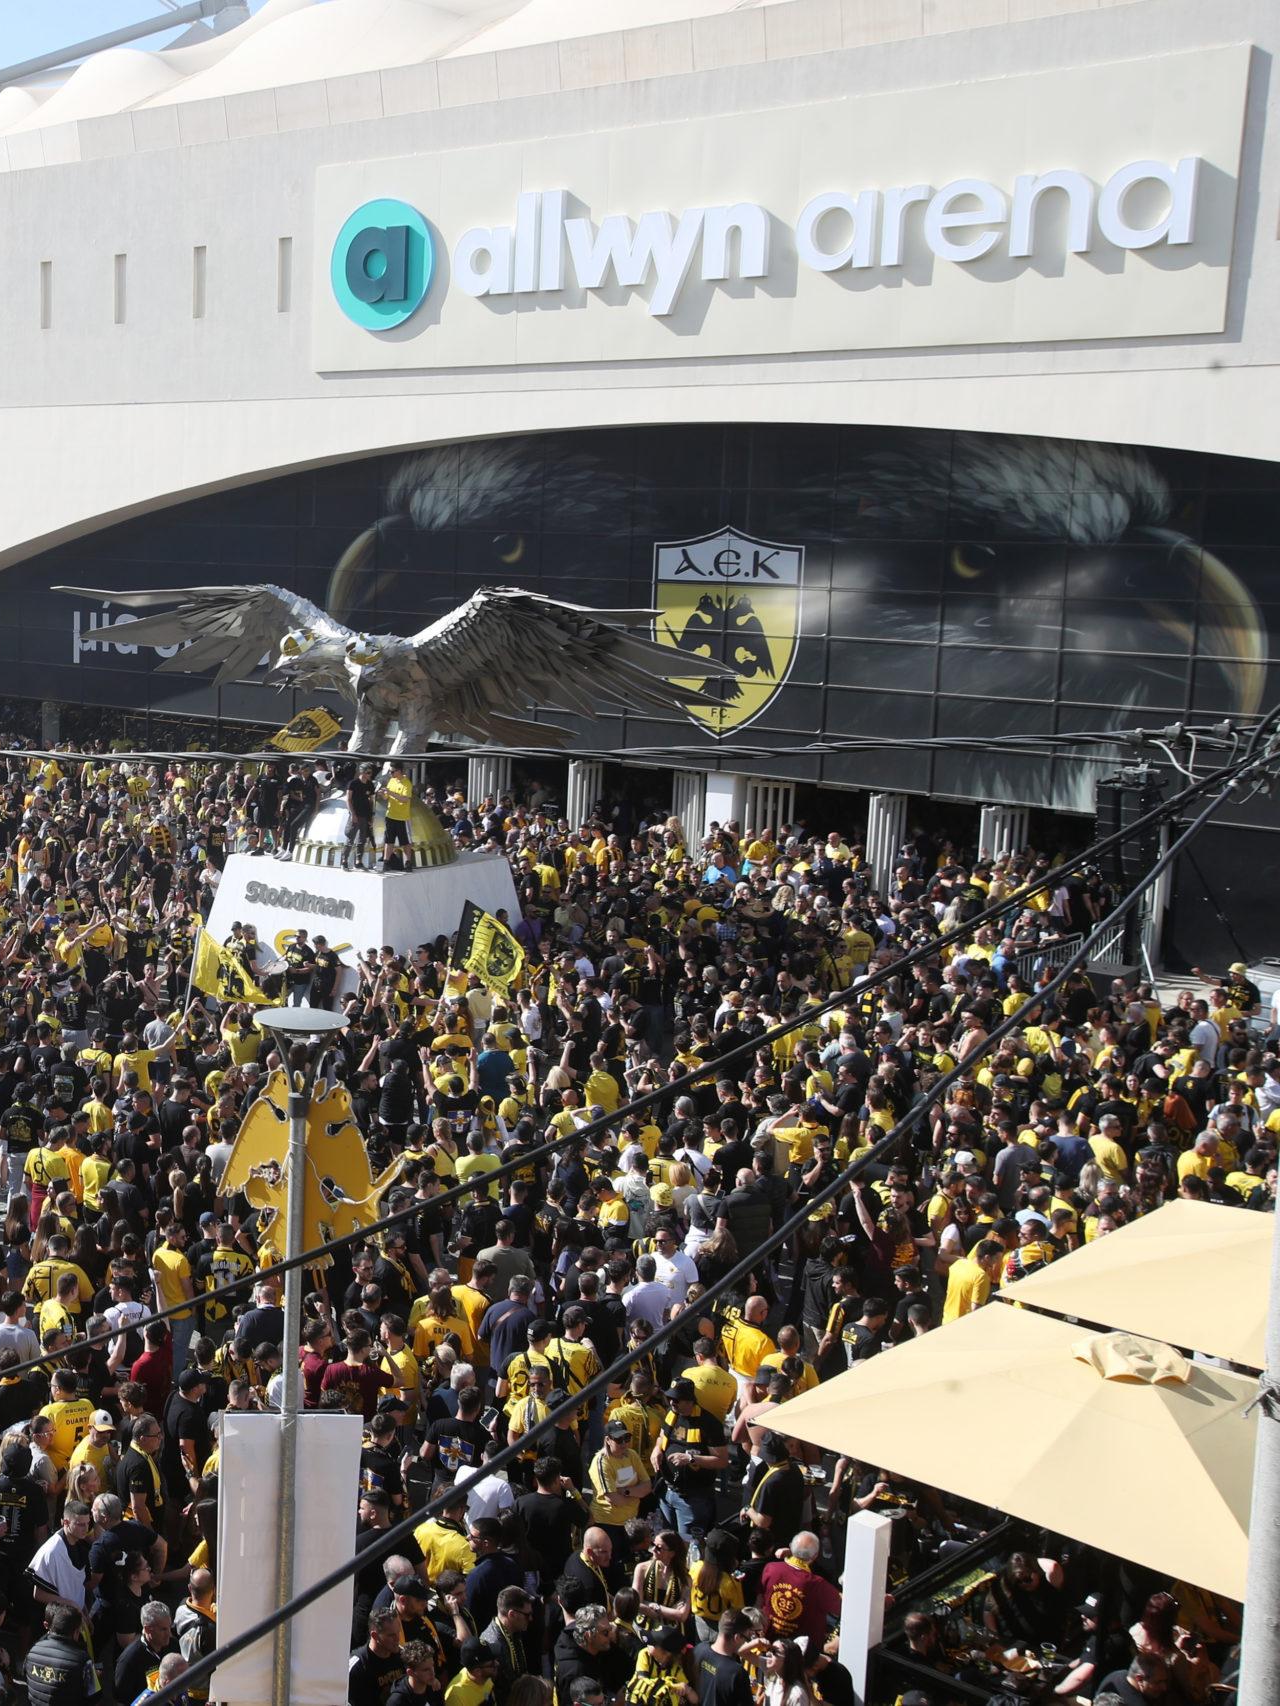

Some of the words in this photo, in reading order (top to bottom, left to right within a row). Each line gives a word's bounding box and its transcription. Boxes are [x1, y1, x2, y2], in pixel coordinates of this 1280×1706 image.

[452, 189, 771, 316] allwyn
[795, 157, 1203, 273] arena
[65, 1416, 89, 1426] DUART
